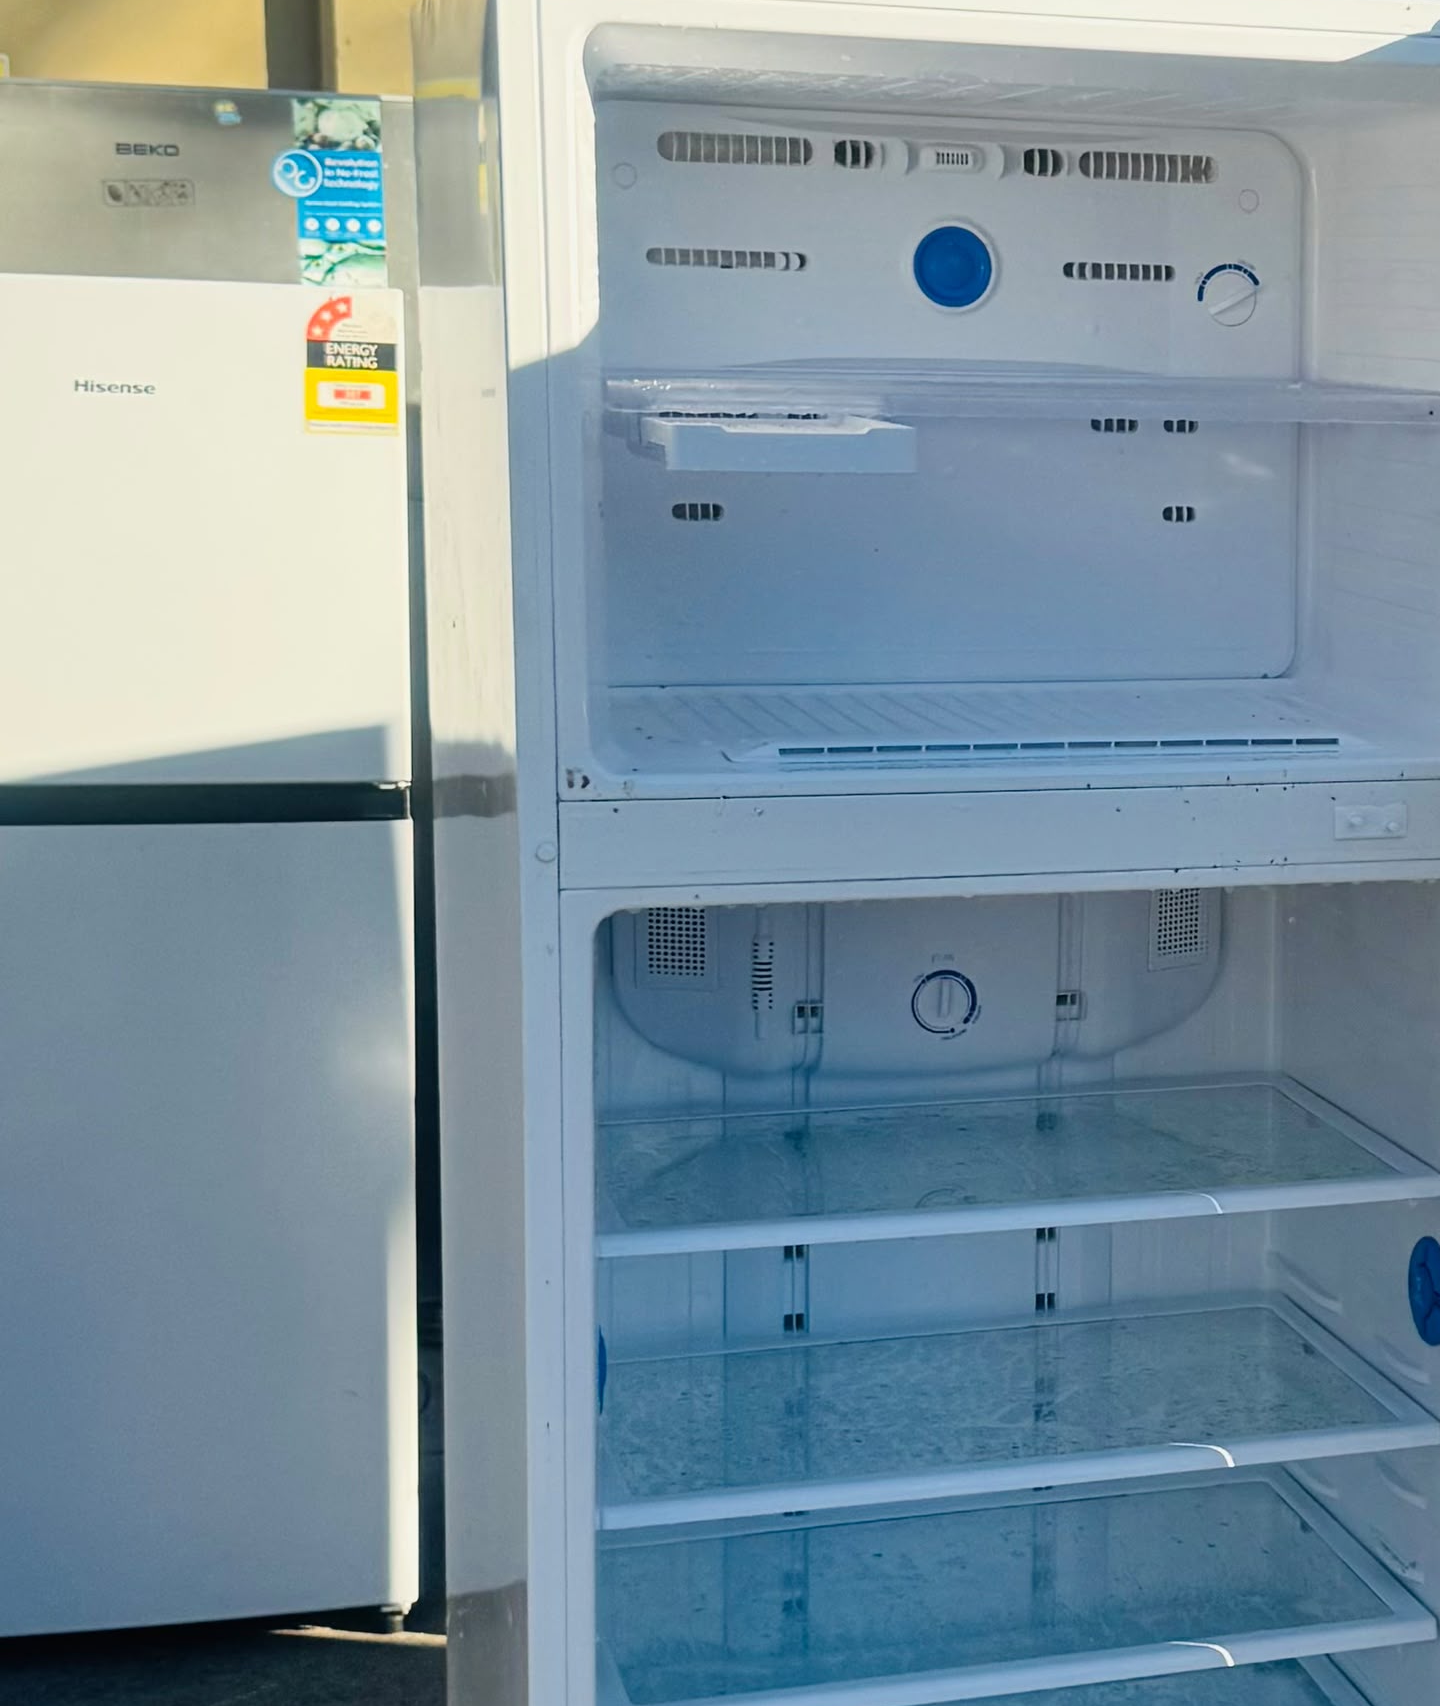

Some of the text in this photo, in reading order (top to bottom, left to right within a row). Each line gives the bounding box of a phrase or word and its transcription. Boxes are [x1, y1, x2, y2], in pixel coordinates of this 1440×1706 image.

[115, 142, 179, 157] BEKO
[326, 342, 378, 357] ENERGY
[326, 355, 378, 370] RATING
[74, 379, 156, 395] Hisense
